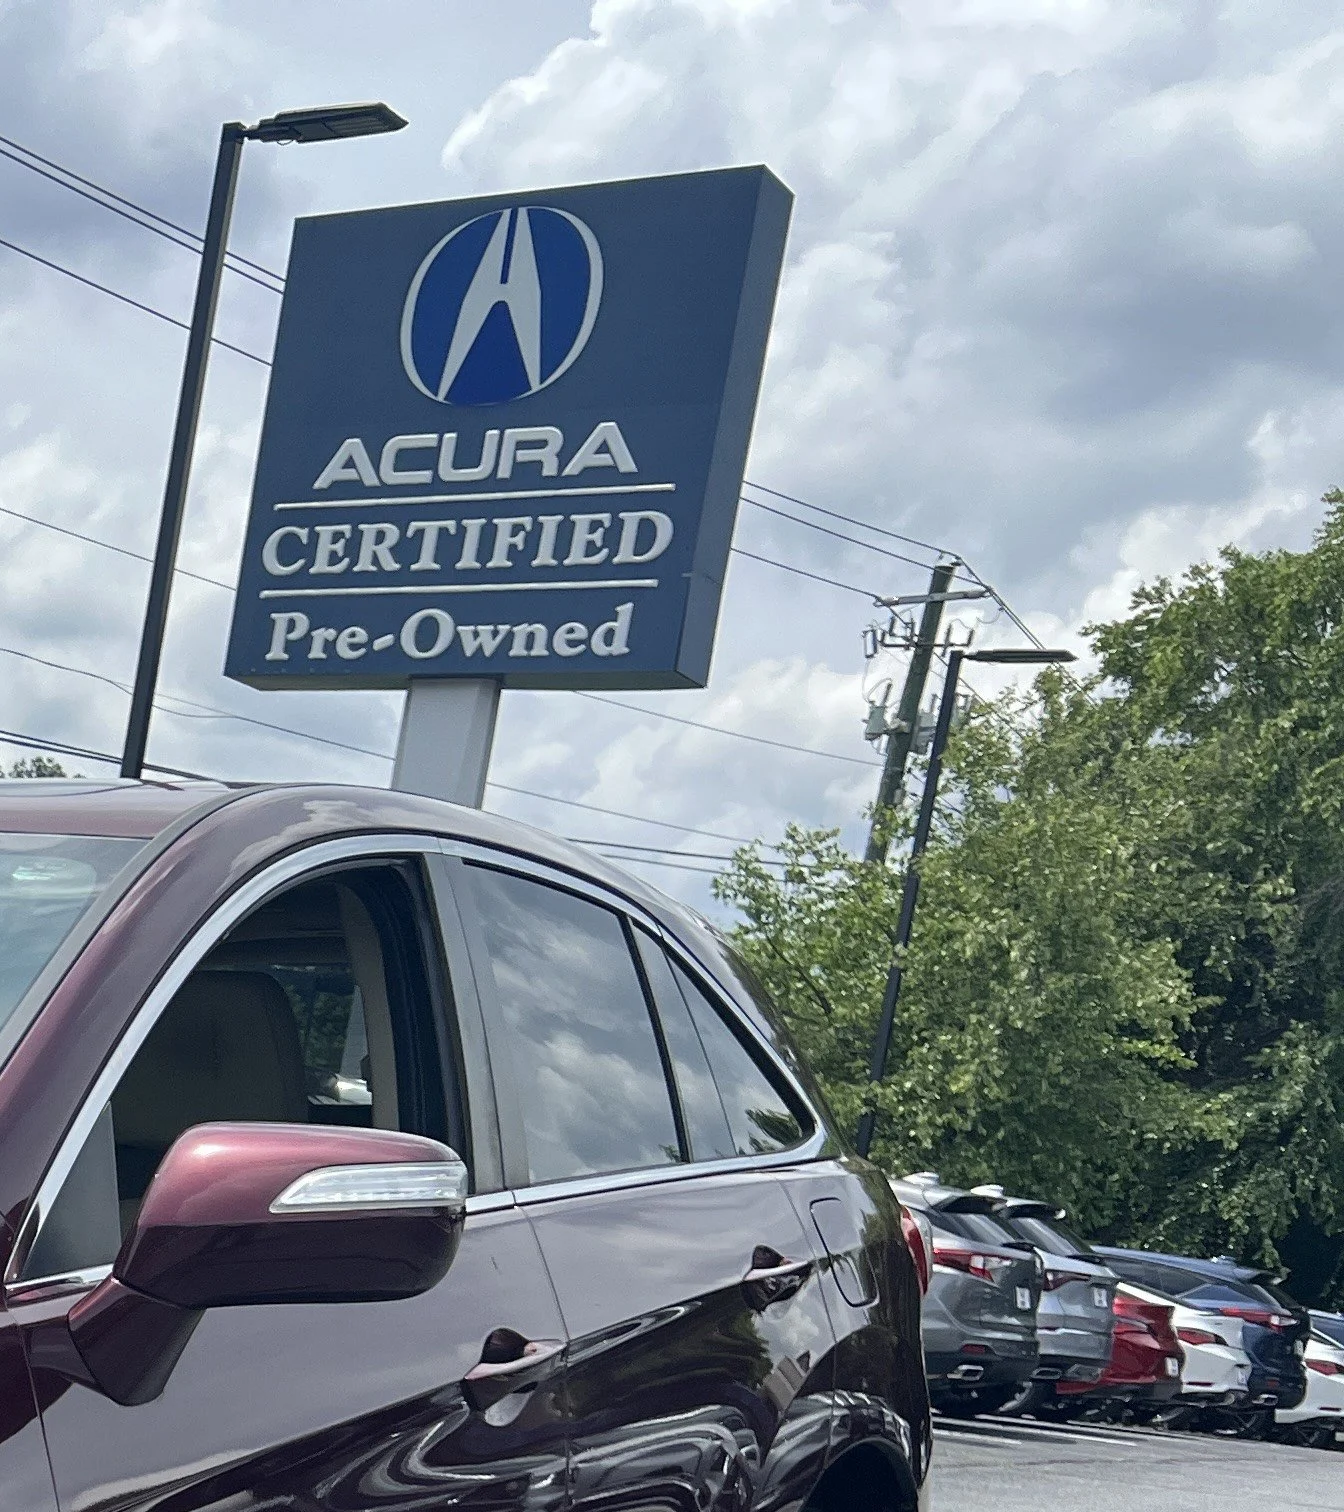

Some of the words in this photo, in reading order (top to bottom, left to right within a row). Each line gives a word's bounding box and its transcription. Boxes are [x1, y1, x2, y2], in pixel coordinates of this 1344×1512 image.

[313, 421, 638, 490] ACURA
[261, 510, 674, 577] CERTIFIED
[265, 603, 634, 662] Pre-Owned
